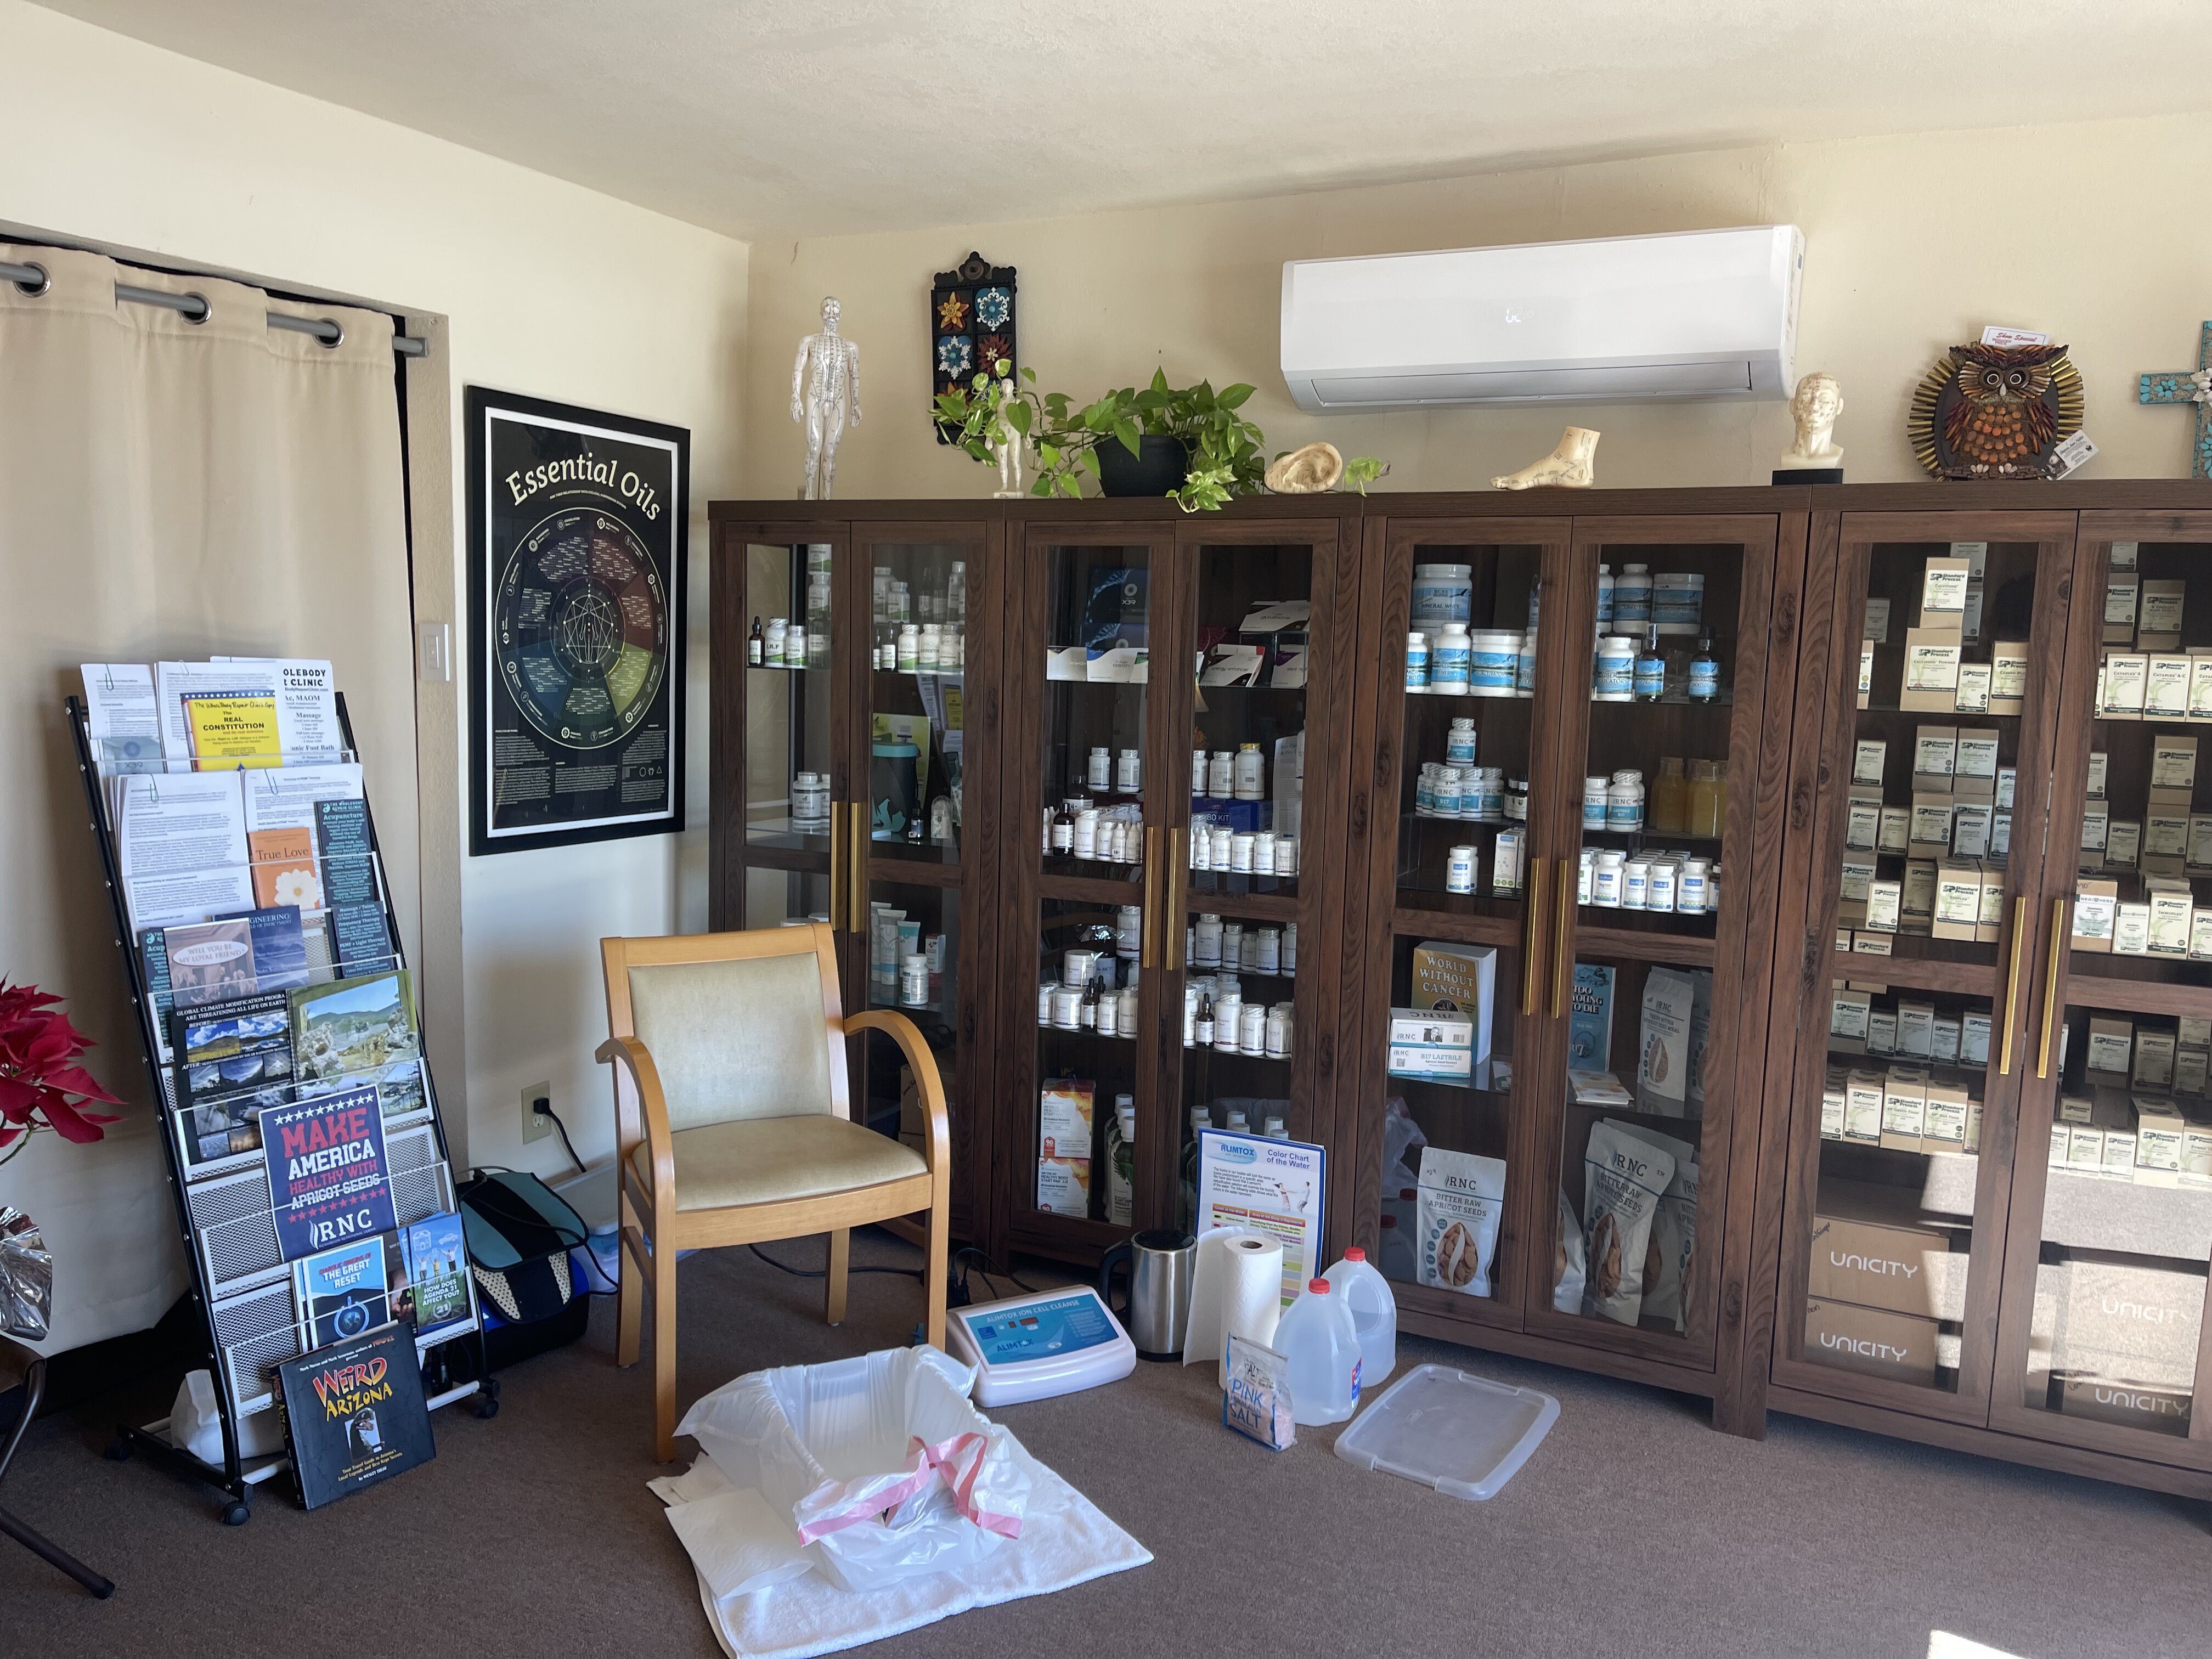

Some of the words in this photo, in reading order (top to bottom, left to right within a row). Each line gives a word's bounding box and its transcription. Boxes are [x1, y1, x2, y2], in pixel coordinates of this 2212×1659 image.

[505, 452, 618, 506] Essential
[620, 471, 661, 521] Oils
[283, 669, 325, 677] OLEBODY
[1218, 814, 1230, 822] KIT
[256, 850, 281, 860] True
[284, 848, 309, 857] Love
[250, 913, 290, 924] GINEERING
[215, 949, 245, 958] FRIEND?
[1427, 956, 1466, 973] WORLD
[1419, 968, 1474, 987] WITHOUT
[1423, 982, 1471, 999] CANCER
[1574, 986, 1592, 995] TOO
[176, 1008, 200, 1017] GLOBAL
[201, 1003, 224, 1012] CLIMATE
[225, 998, 263, 1008] MODIFICATION
[264, 994, 285, 1002] PROGRA
[1572, 995, 1603, 1005] YOUNG
[1658, 1001, 1672, 1013] RNC
[199, 1008, 236, 1019] THREATENING
[1583, 1004, 1599, 1013] DIE
[189, 1020, 211, 1028] BEFORE:
[1667, 1025, 1680, 1034] MEAL
[281, 1107, 369, 1158] MAKE
[1221, 1143, 1255, 1156] ALIMTOX
[1267, 1149, 1288, 1158] Color
[1290, 1152, 1309, 1162] Chart
[289, 1138, 376, 1180] AMERICA
[1276, 1158, 1287, 1166] the
[1289, 1160, 1310, 1170] Water
[1616, 1154, 1647, 1177] RNC
[289, 1169, 344, 1195] HEALTHY
[346, 1159, 378, 1178] WITH
[1449, 1176, 1476, 1190] RNC
[291, 1184, 340, 1210] APRICOT
[342, 1173, 380, 1194] SEEDS
[1625, 1184, 1642, 1199] RAW
[1436, 1193, 1463, 1204] BITTER
[1464, 1198, 1481, 1207] RAW
[1620, 1194, 1642, 1213] SEEDS
[1429, 1200, 1462, 1212] APRICOT
[1463, 1207, 1487, 1217] SEEDS
[318, 1209, 372, 1242] RNC
[323, 1268, 341, 1282] THE
[342, 1259, 370, 1275] GREAT
[1830, 1251, 1918, 1278] UNICITY
[334, 1272, 360, 1289] RESET
[424, 1284, 440, 1294] HOW
[441, 1279, 456, 1288] DOES
[422, 1296, 443, 1306] AFFECT
[444, 1290, 460, 1298] YOU?
[424, 1289, 450, 1300] AGENDA
[436, 1303, 449, 1314] 21
[987, 1312, 1017, 1323] ALIMTOX
[1034, 1306, 1050, 1314] CELL
[1050, 1300, 1080, 1310] CLEANSE
[1820, 1333, 1907, 1362] UNICITY
[1232, 1379, 1263, 1408] PINK
[2095, 1388, 2189, 1417] UNICITY
[1230, 1403, 1261, 1429] SALT
